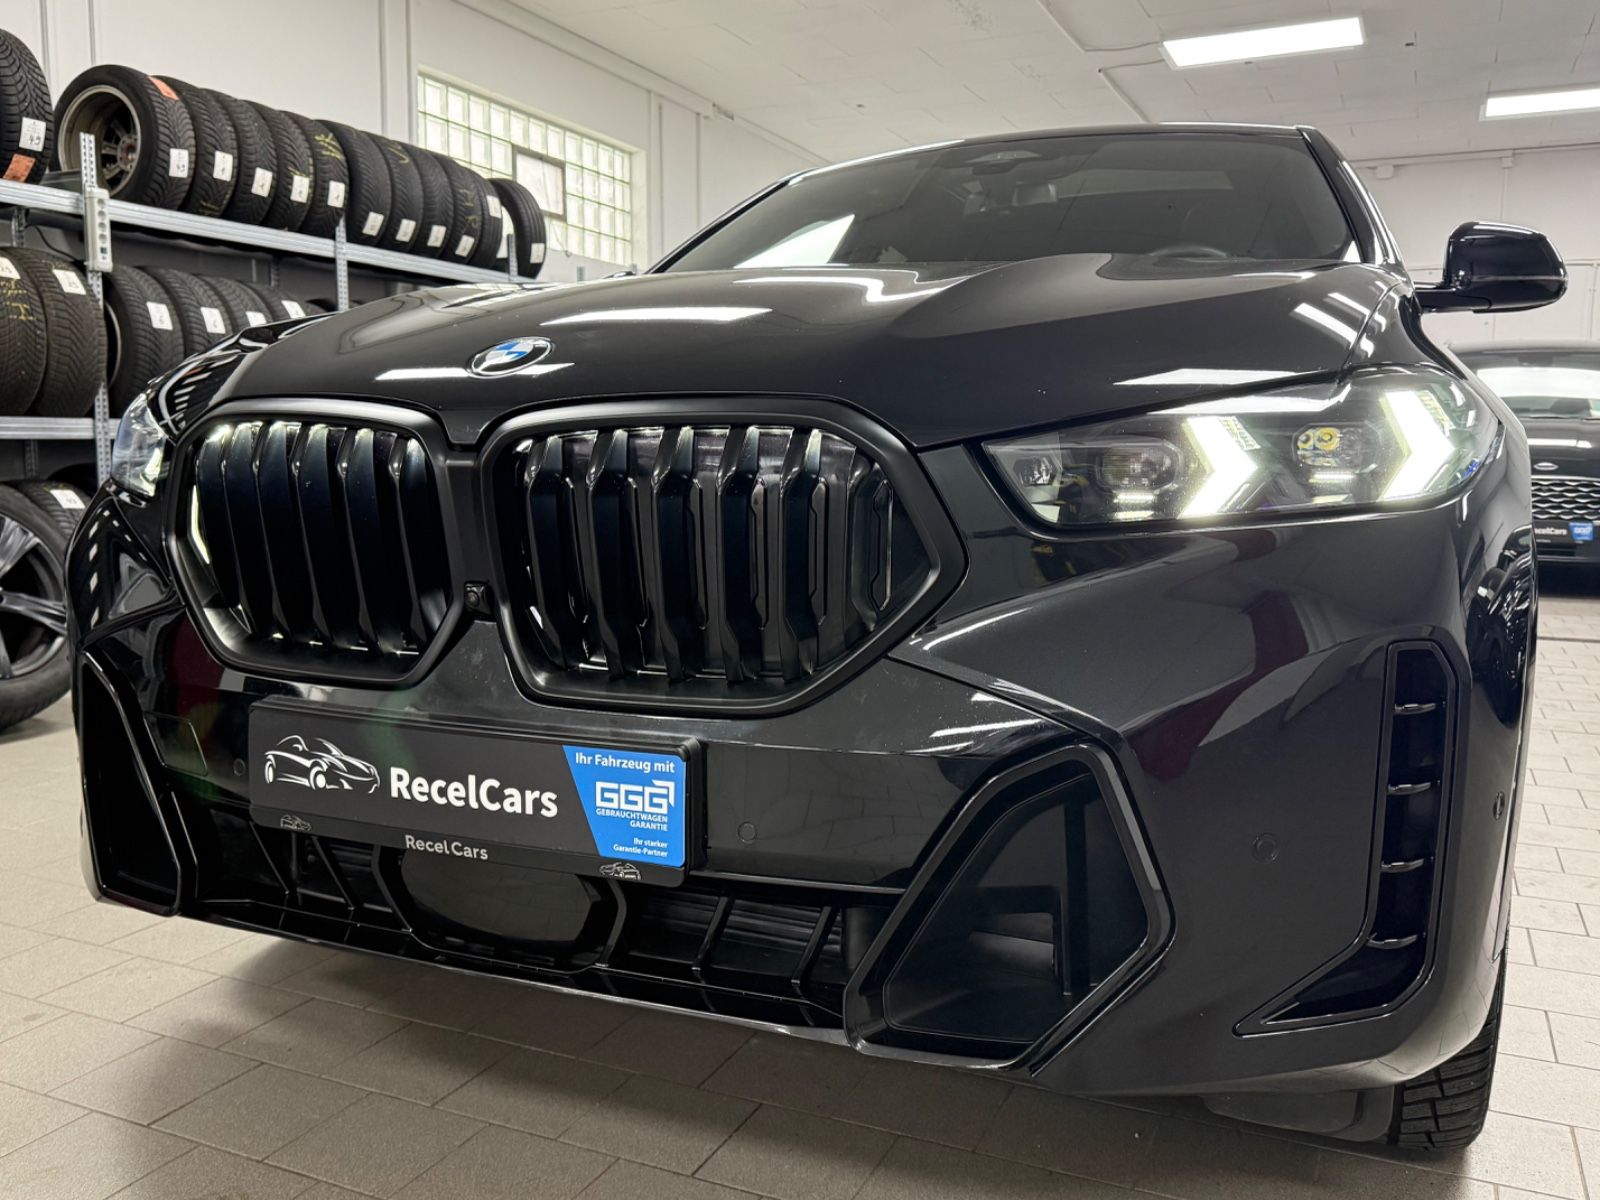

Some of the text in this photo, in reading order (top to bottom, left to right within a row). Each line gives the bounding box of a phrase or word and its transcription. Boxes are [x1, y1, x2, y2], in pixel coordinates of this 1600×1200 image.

[575, 752, 675, 774] Ihr Fahrzeug mit
[390, 766, 558, 818] RecelCars
[595, 808, 668, 823] GEBRAUCHTWAGEN
[630, 820, 668, 832] GARANTIE
[405, 834, 488, 860] Recel Cars
[633, 837, 668, 848] Ihr starker
[613, 843, 668, 858] Garantie-Partner
